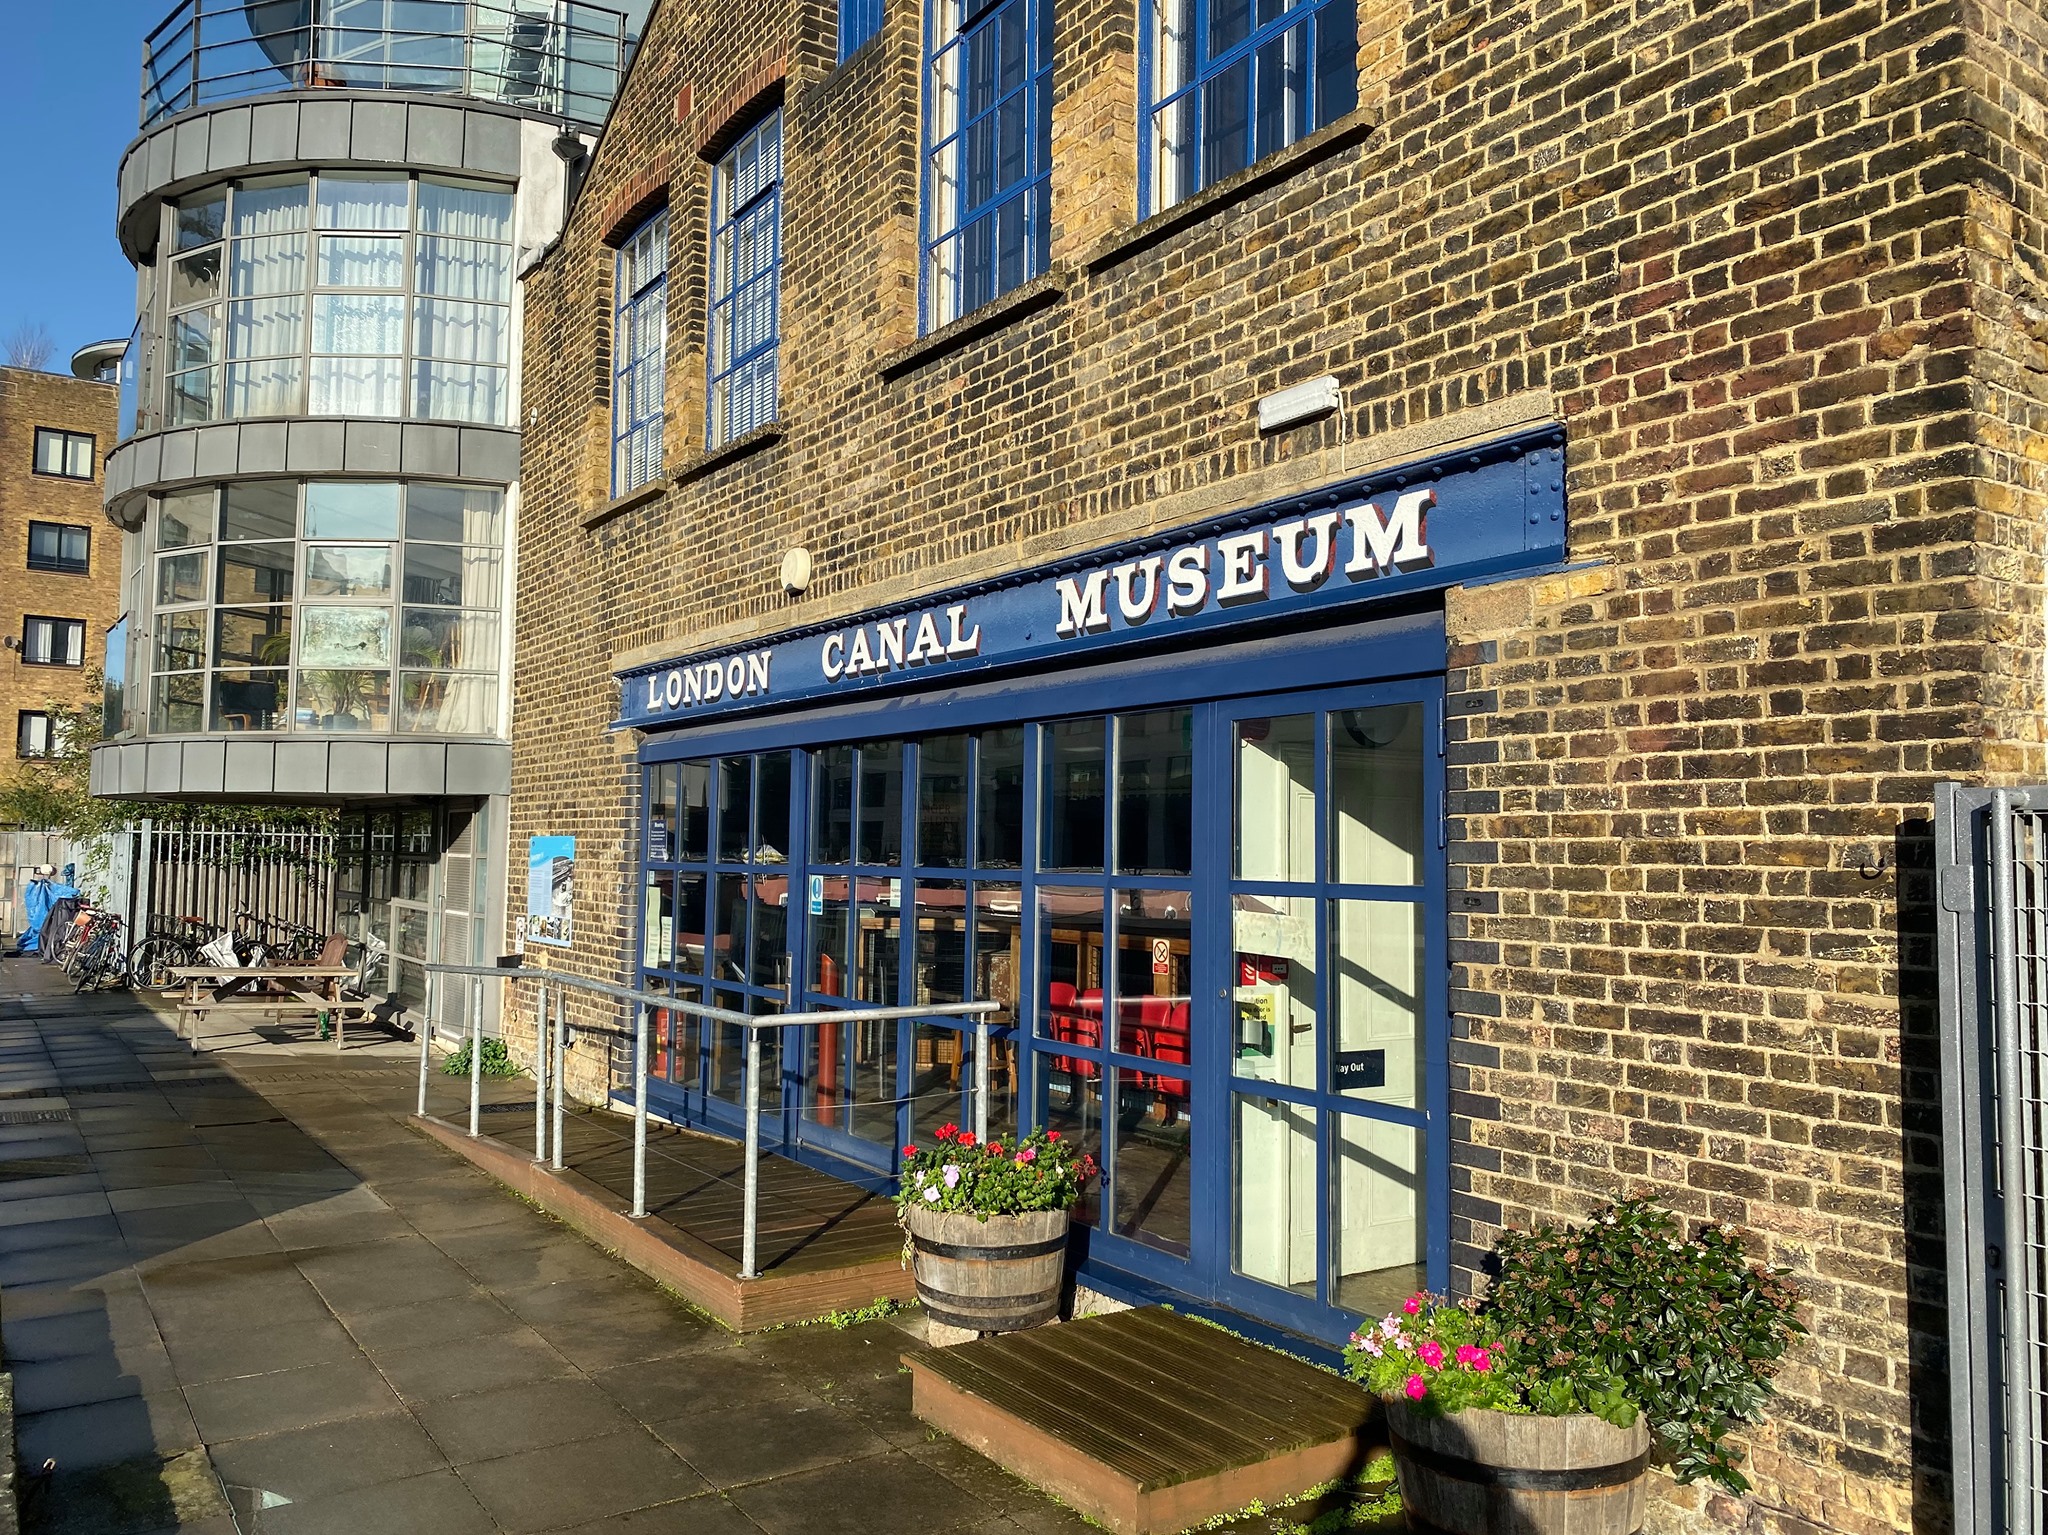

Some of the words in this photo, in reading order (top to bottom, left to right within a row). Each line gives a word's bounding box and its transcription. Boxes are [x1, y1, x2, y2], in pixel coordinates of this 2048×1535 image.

[647, 651, 773, 714] LONDON
[821, 605, 982, 684] CANAL
[1055, 488, 1437, 640] MUSEUM
[1350, 1062, 1365, 1072] Out
